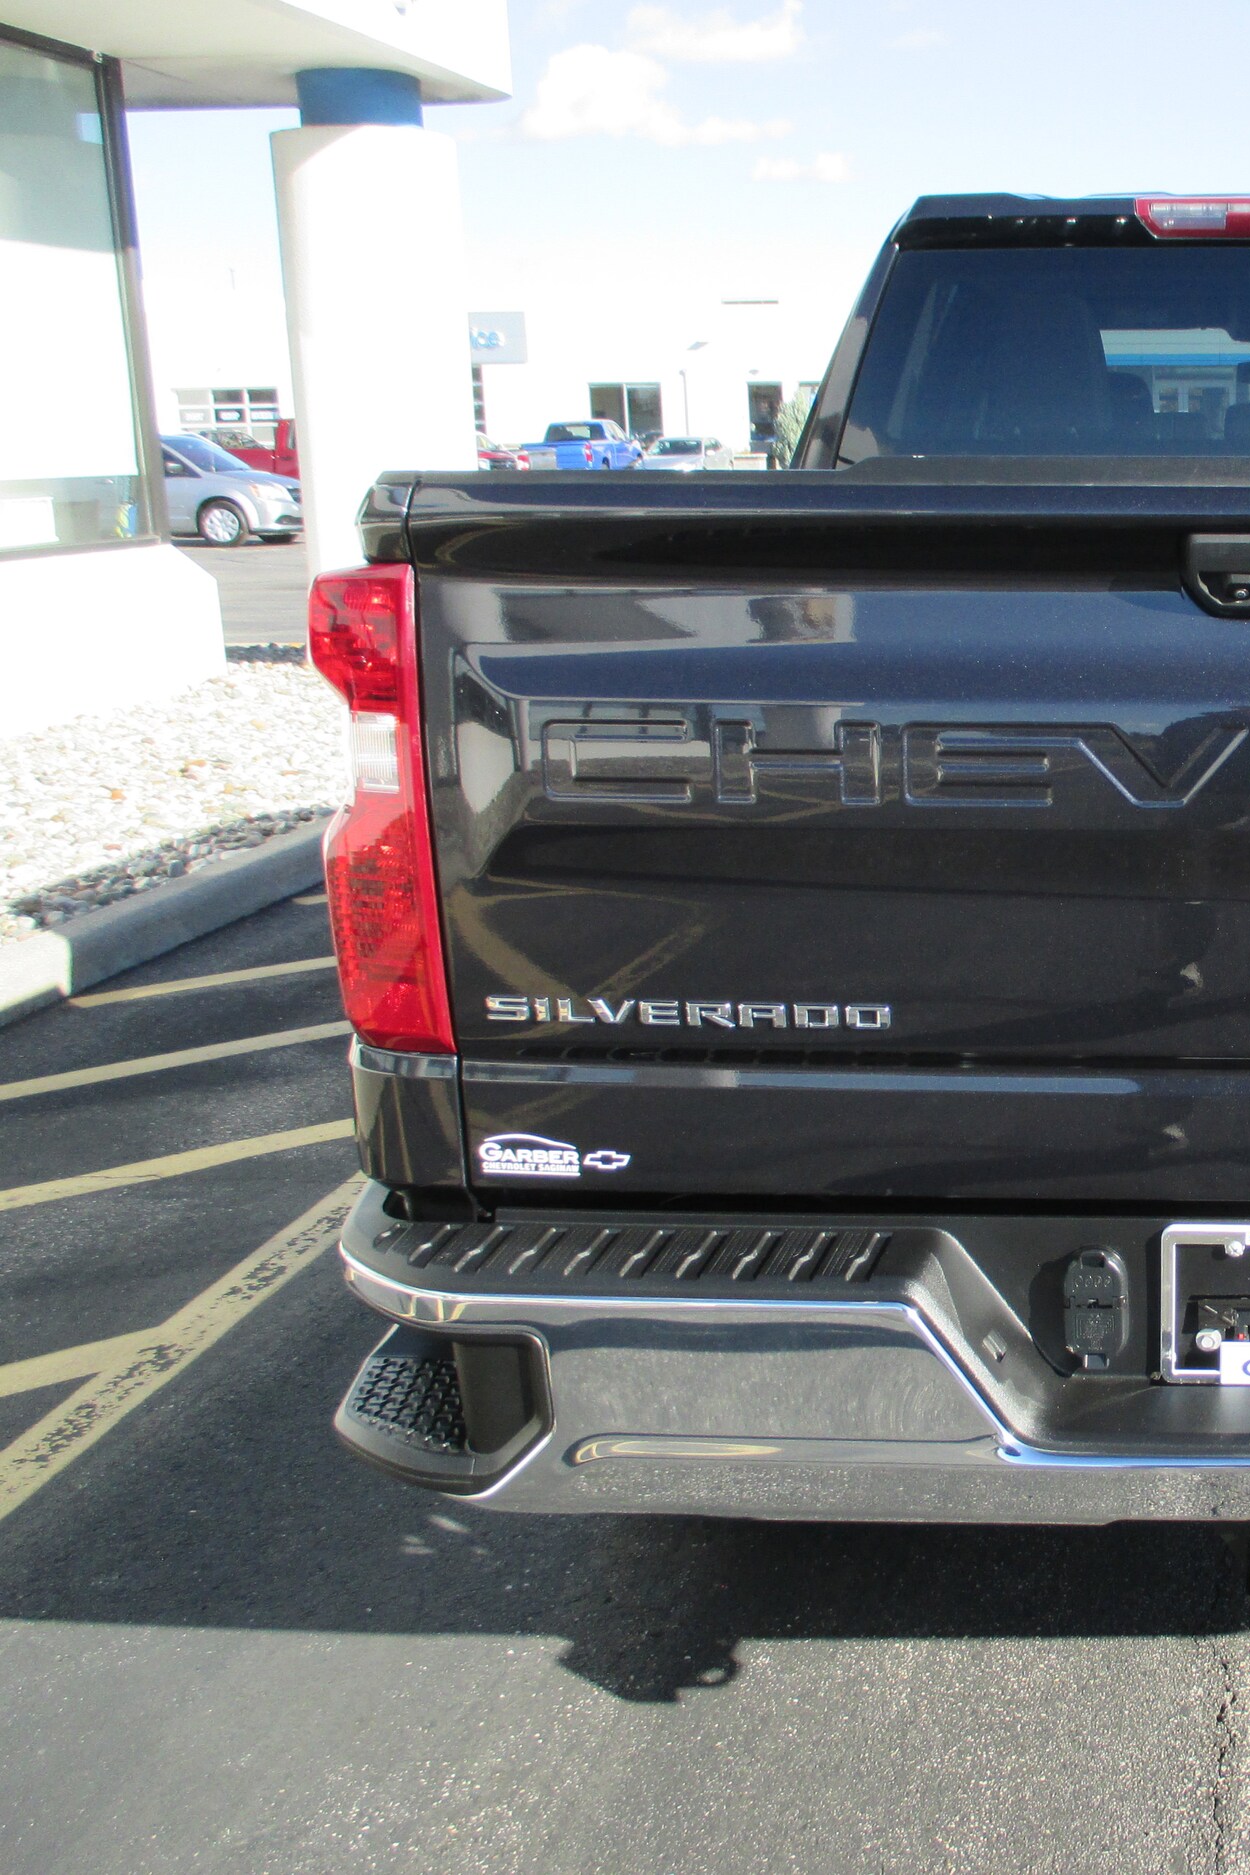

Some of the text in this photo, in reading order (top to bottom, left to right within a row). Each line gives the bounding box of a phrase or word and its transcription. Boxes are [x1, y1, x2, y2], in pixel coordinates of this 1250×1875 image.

[486, 996, 892, 1029] SILVERADO
[479, 1142, 580, 1165] GARBER
[482, 1161, 580, 1173] CHEVROLET SAGINAW
